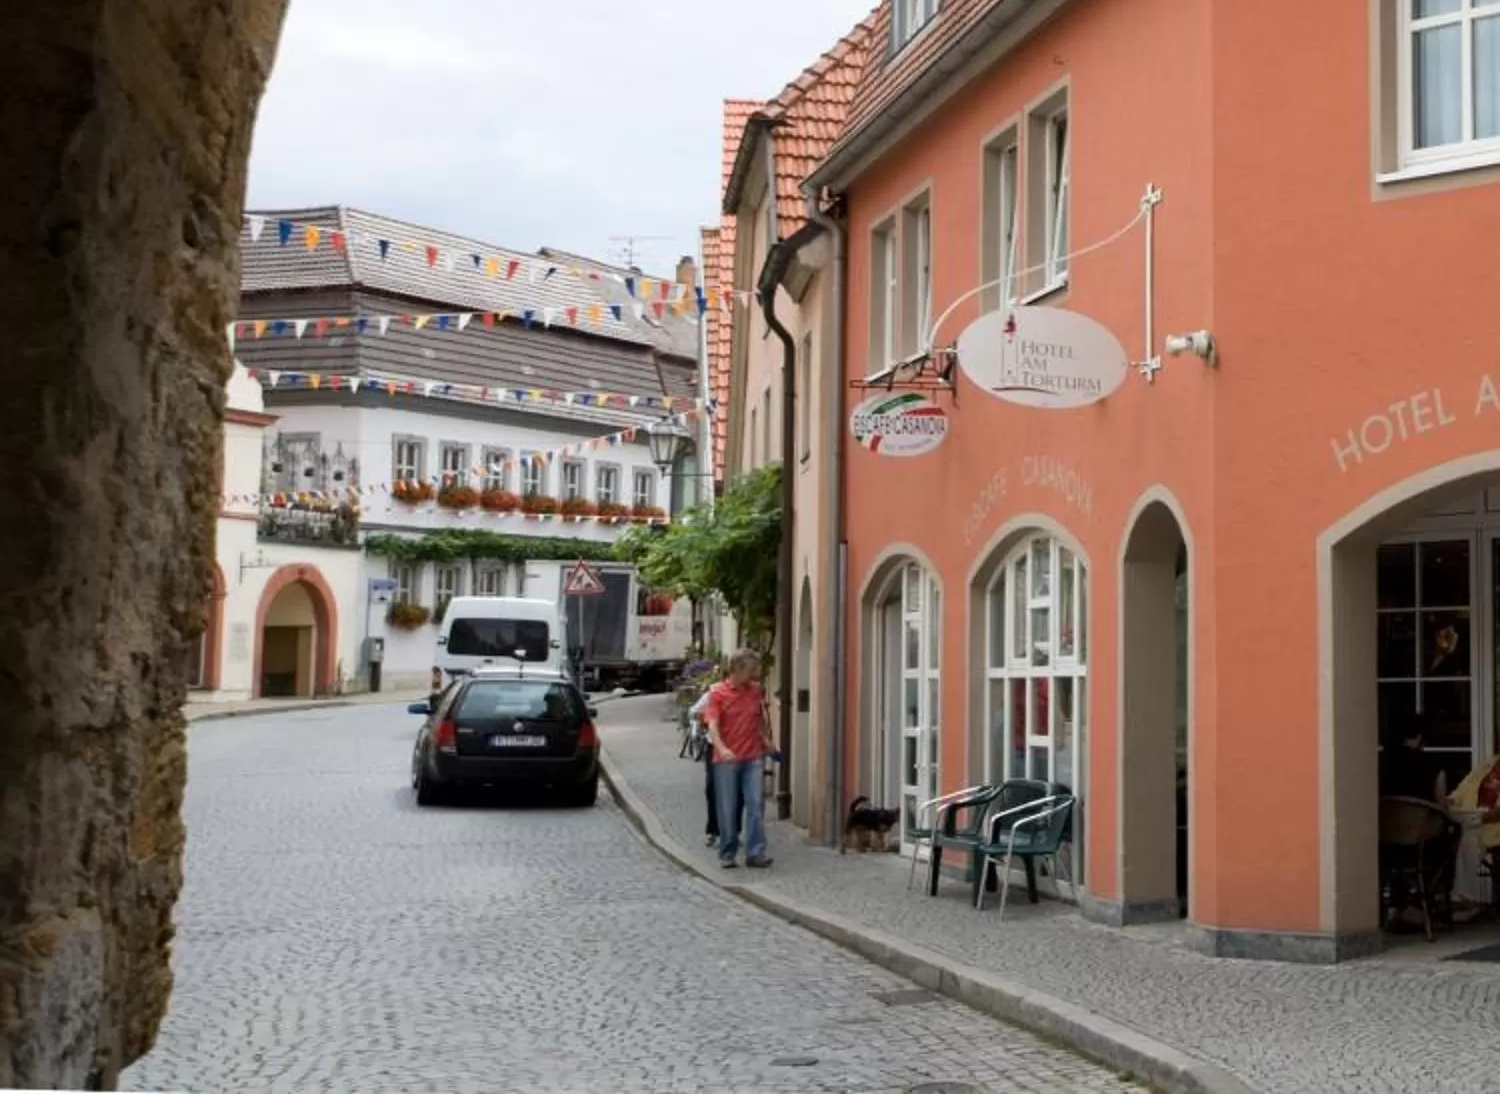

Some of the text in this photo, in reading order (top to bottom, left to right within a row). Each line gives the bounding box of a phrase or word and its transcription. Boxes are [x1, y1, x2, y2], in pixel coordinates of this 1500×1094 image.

[1021, 340, 1073, 359] HOTEL
[1021, 357, 1048, 371] AM
[1022, 371, 1102, 392] TORTURM
[1329, 387, 1457, 474] HOTEL
